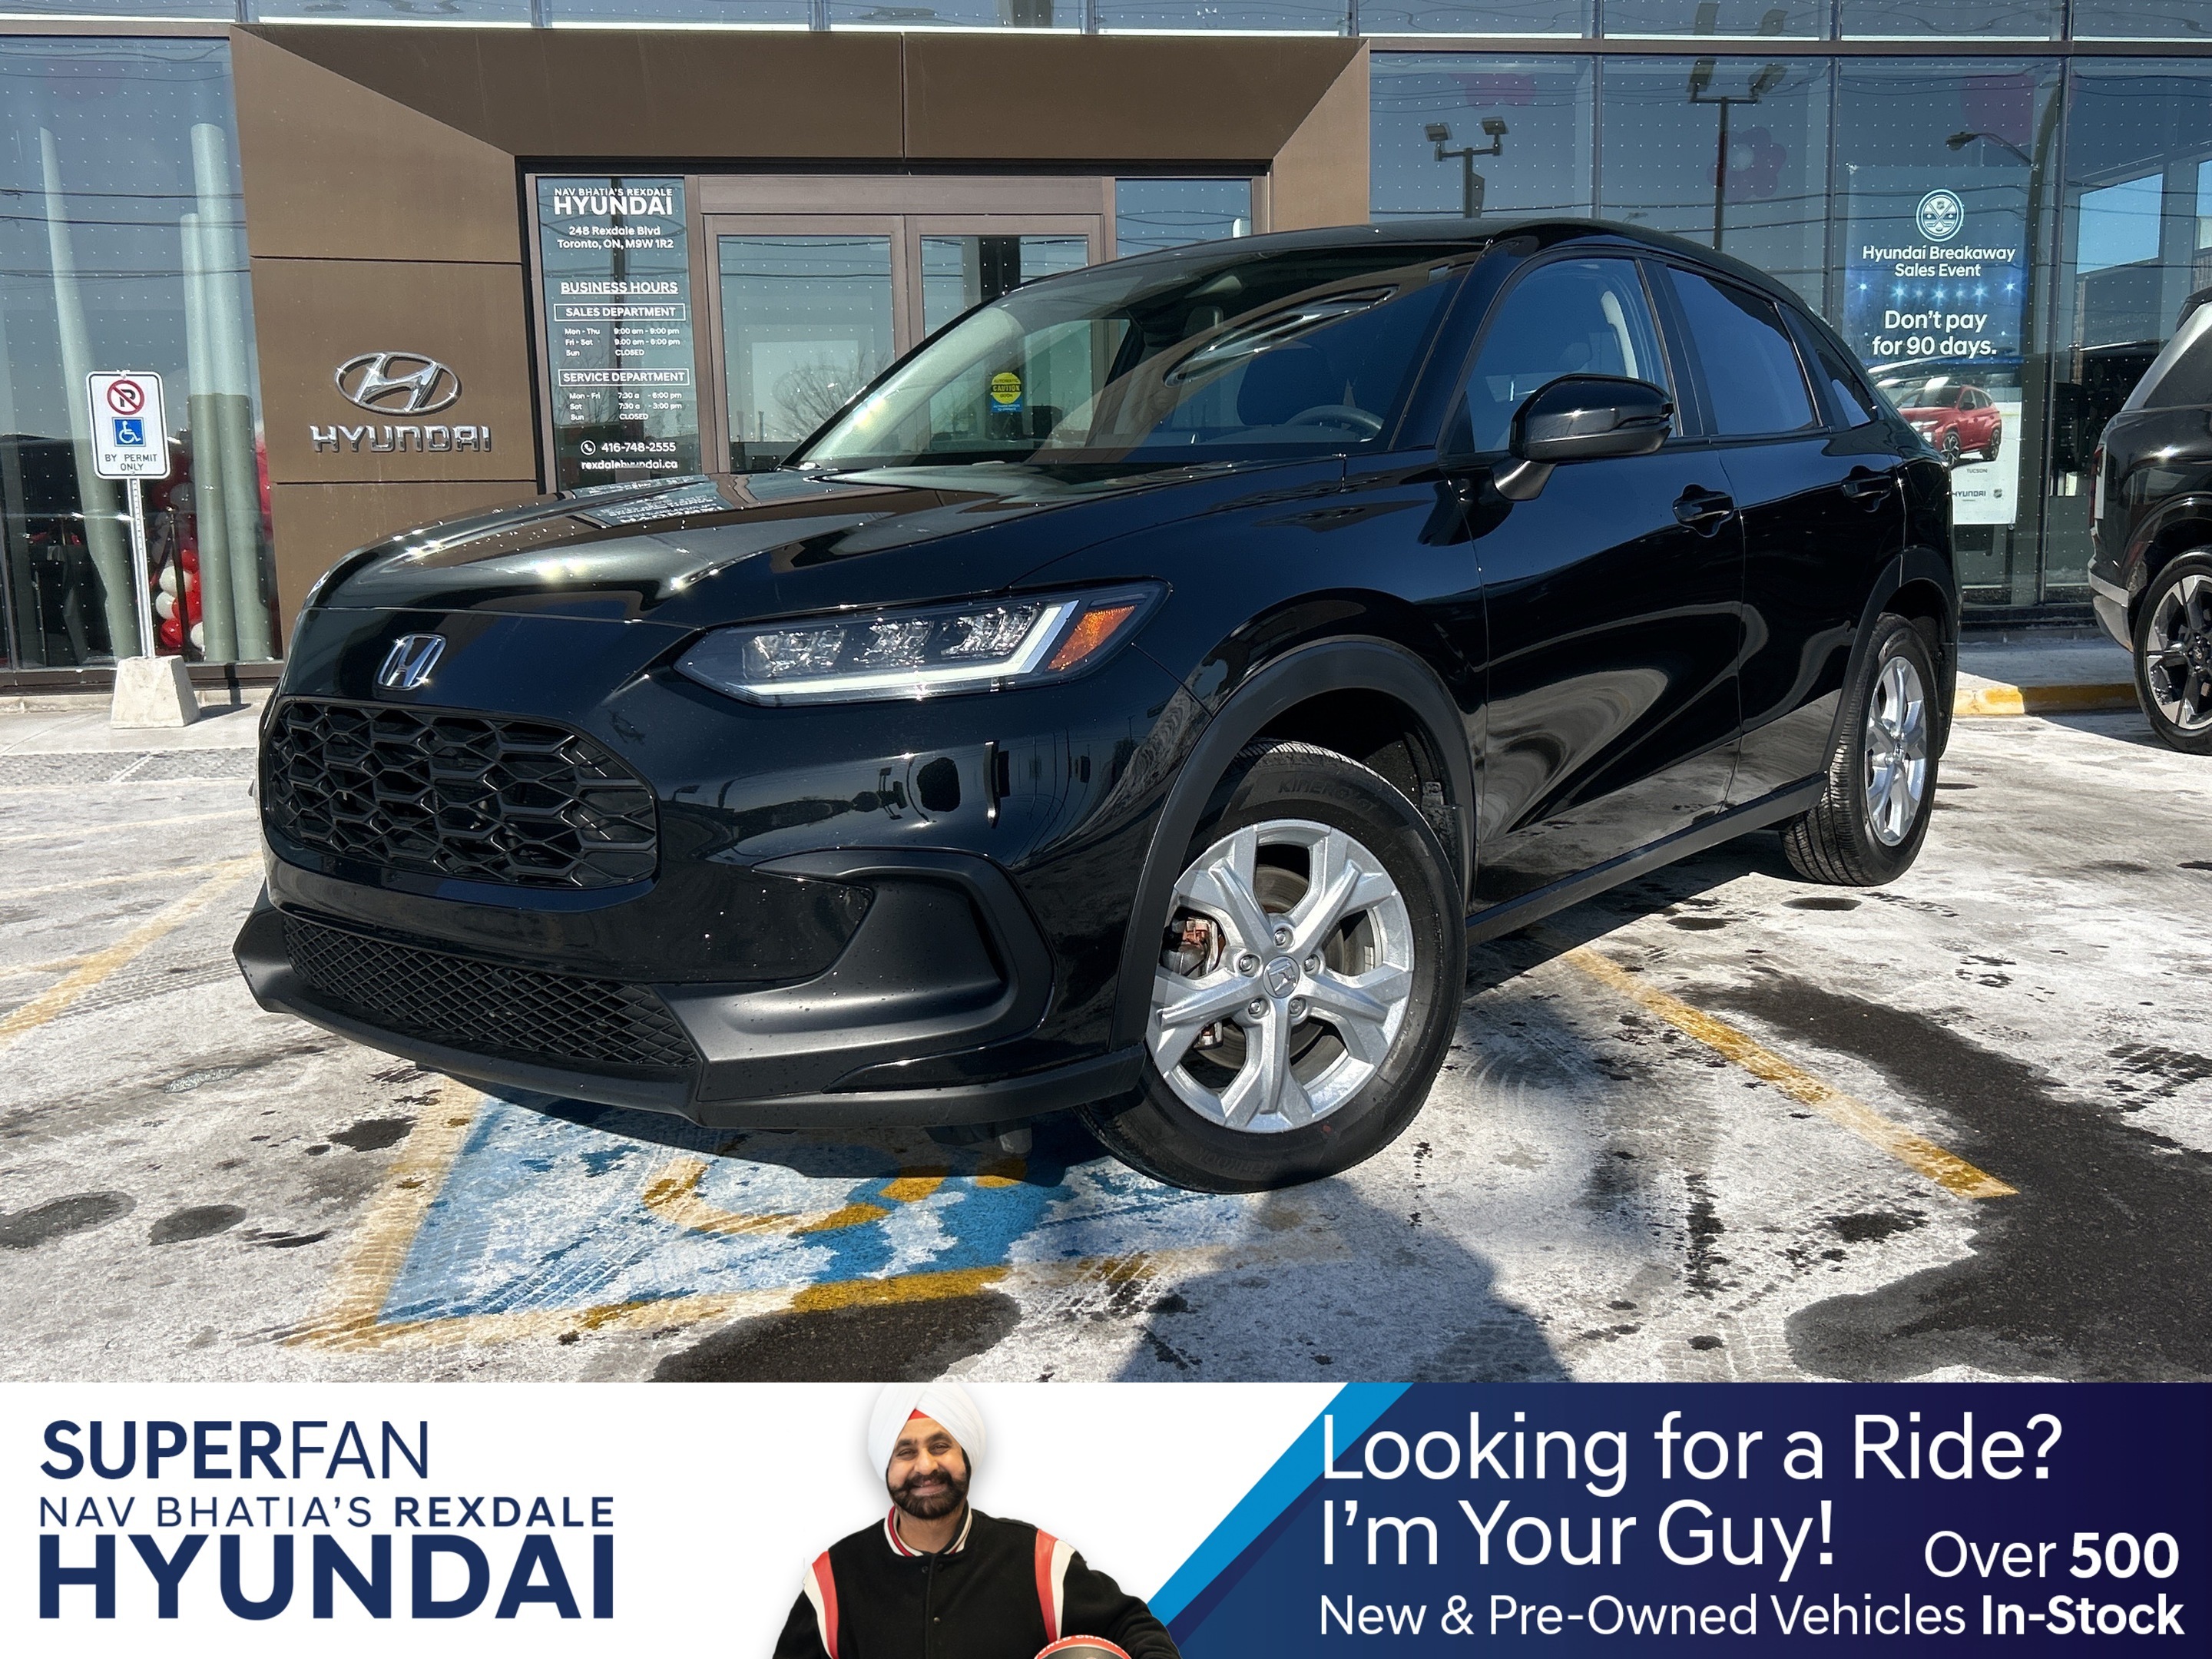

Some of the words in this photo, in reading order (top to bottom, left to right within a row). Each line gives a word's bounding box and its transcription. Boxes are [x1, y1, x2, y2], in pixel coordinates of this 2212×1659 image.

[554, 196, 673, 215] HYUNDAI
[569, 226, 590, 235] 248
[592, 226, 634, 235] Rexdale
[637, 226, 661, 235] Blvd
[558, 240, 601, 250] Toronto,
[604, 240, 624, 250] ON,
[626, 240, 653, 248] M9W
[655, 240, 674, 248] 1R2
[1863, 245, 1926, 262] Hyundai
[1930, 246, 2016, 262] Breakaway
[1895, 263, 1935, 276] Sales
[1939, 263, 1981, 276] Event
[561, 282, 628, 293] BUSINESS
[631, 282, 678, 293] HOURS
[566, 307, 600, 316] SALES
[603, 307, 676, 316] DEPARTMENT
[1885, 310, 1942, 329] Don't
[1946, 314, 1988, 333] pay
[1872, 336, 1902, 356] for
[1906, 336, 1935, 355] 90
[1940, 336, 1997, 359] days.
[563, 373, 609, 382] SERVICE
[612, 373, 685, 382] DEPARTMENT
[310, 426, 492, 452] HYUNDAI
[601, 442, 676, 452] 416-748-2555
